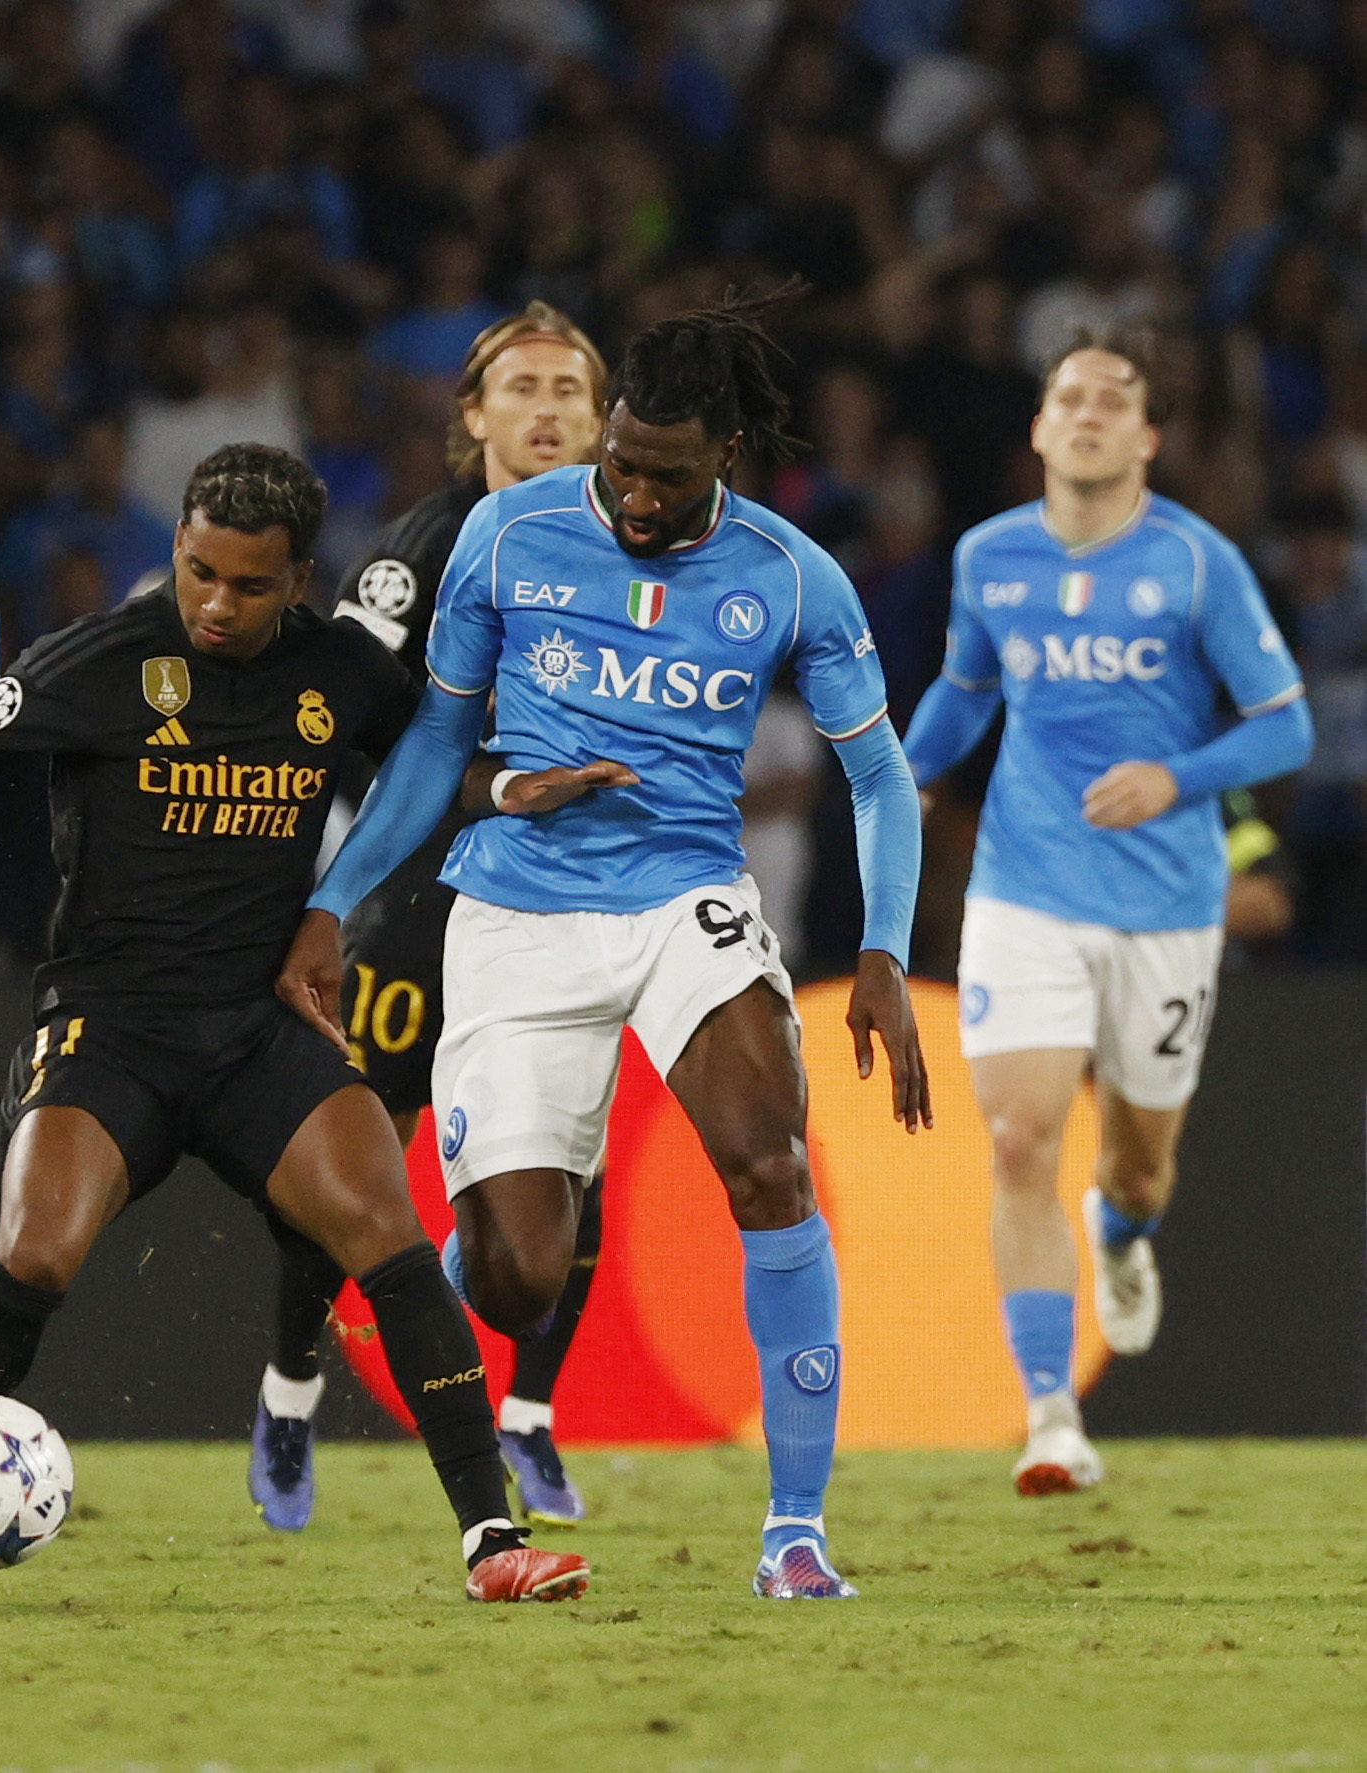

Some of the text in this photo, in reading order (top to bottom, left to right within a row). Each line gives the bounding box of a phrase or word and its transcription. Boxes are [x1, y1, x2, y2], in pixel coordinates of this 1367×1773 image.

[514, 580, 578, 607] EA7
[728, 604, 754, 632] N
[1042, 633, 1167, 683] MSC
[591, 647, 753, 711] MSC
[139, 755, 326, 800] Emirates
[162, 801, 299, 838] FLY BETTER
[350, 964, 425, 1053] 10
[804, 1355, 829, 1380] N
